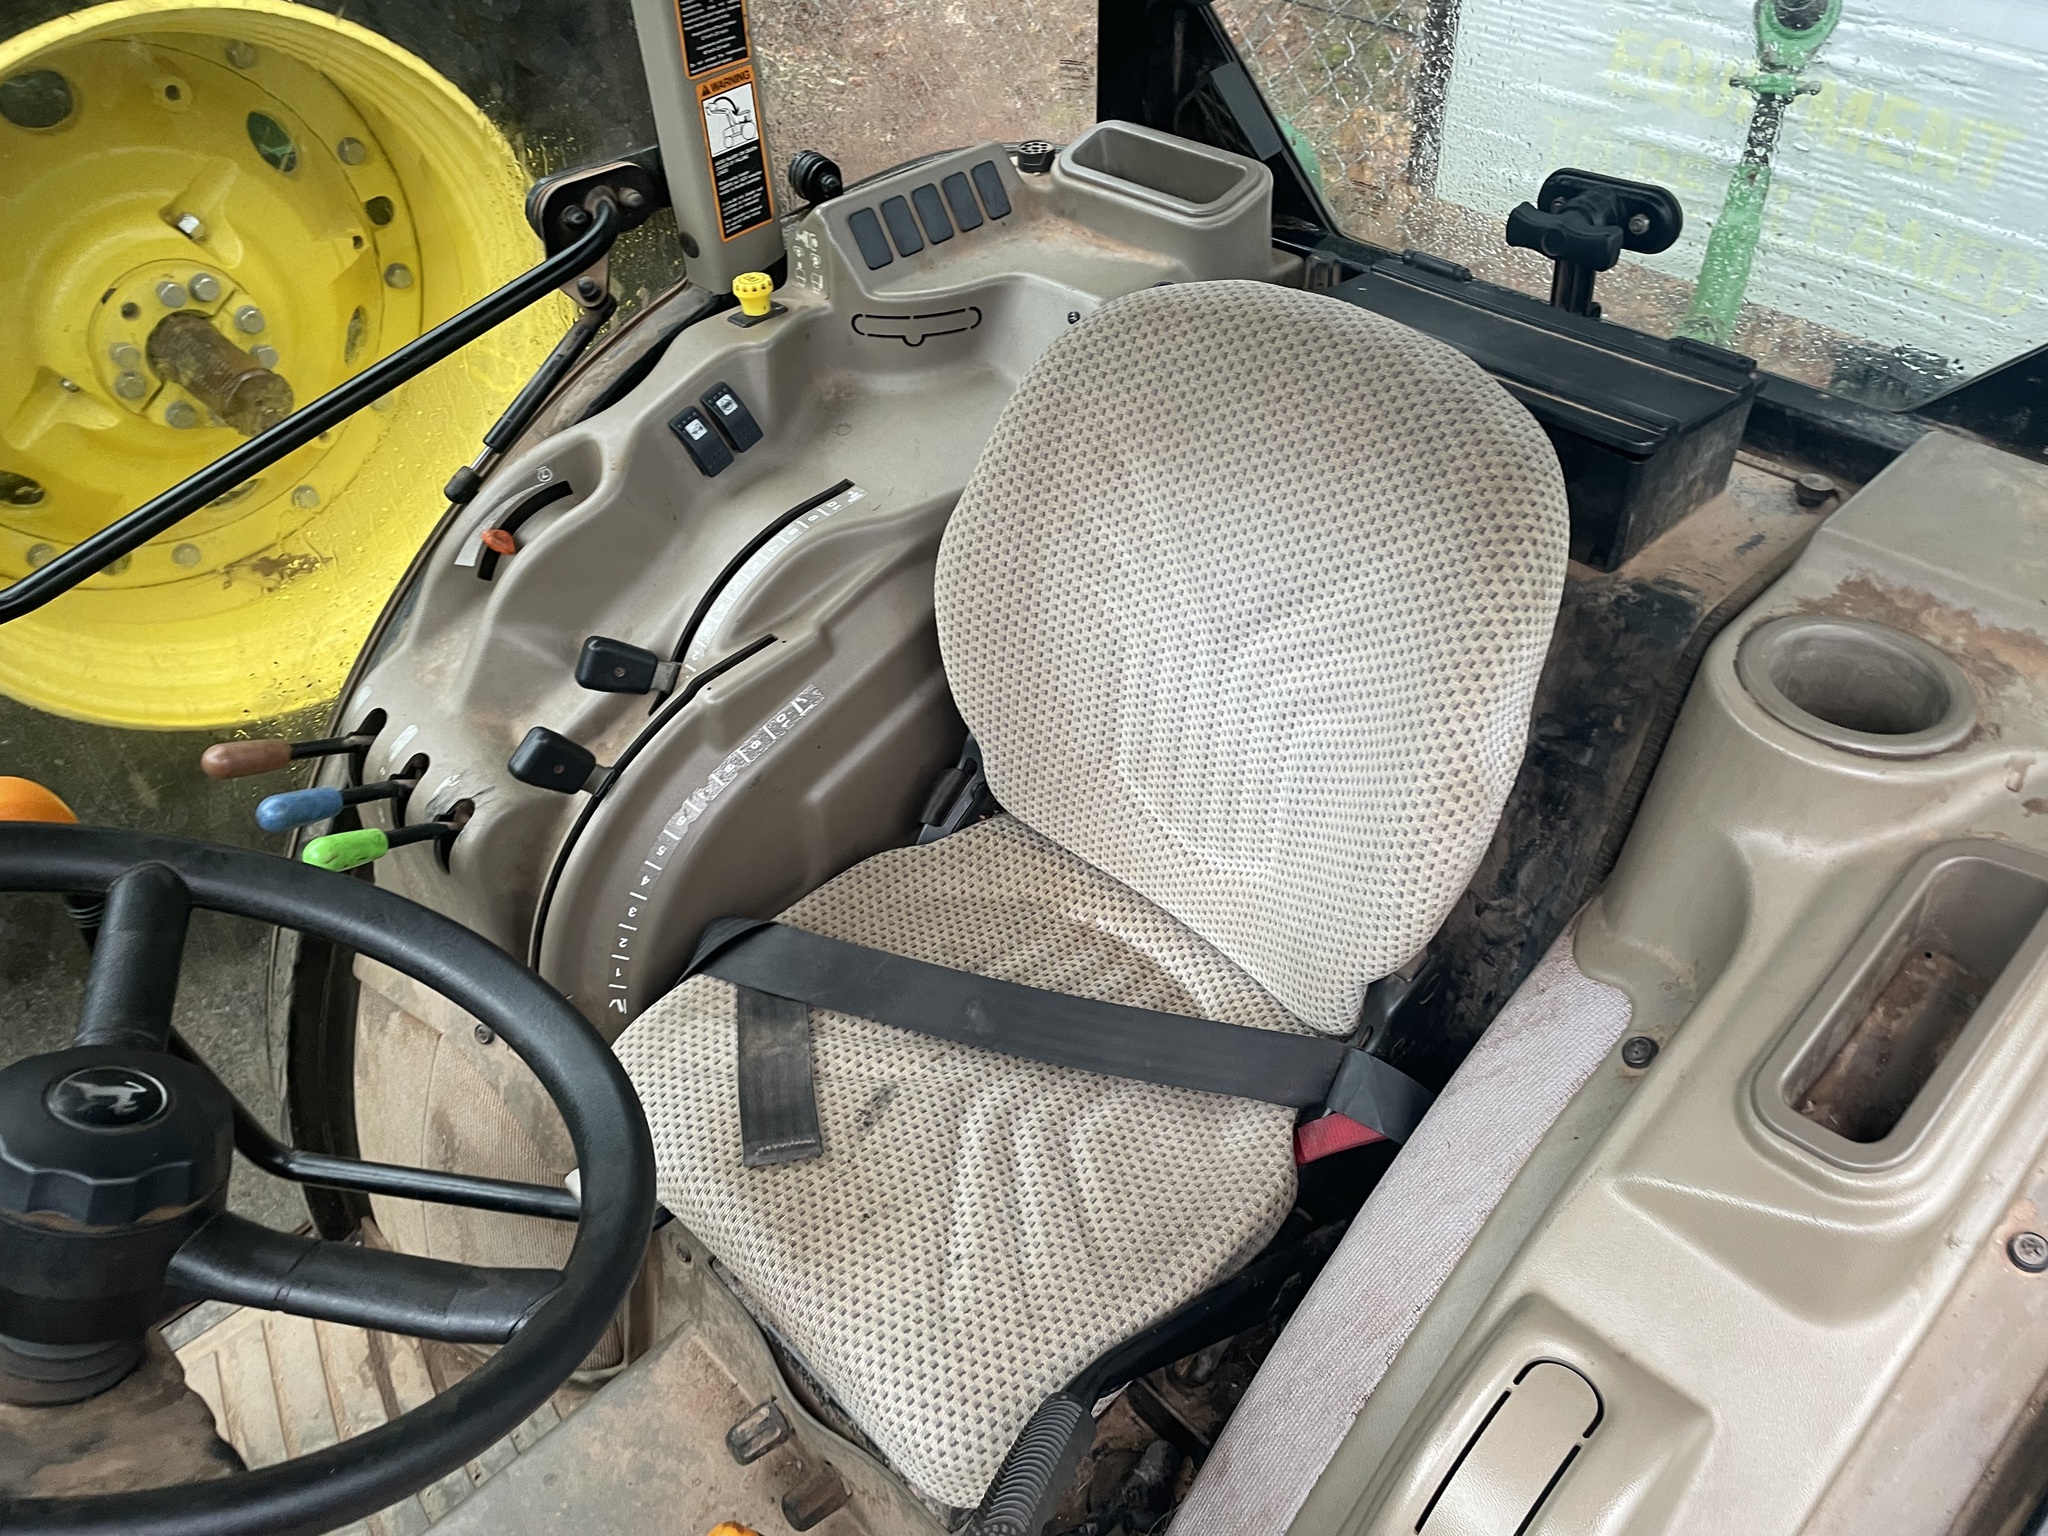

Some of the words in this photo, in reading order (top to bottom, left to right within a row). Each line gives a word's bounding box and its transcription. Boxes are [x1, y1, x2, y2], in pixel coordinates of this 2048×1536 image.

[710, 70, 751, 93] WARNING
[1604, 25, 2028, 192] EQUIMENT
[1541, 113, 1615, 177] TO
[1632, 141, 1713, 195] BE
[1756, 180, 2042, 317] LEANED
[826, 500, 842, 512] 10
[776, 713, 790, 728] 10
[676, 815, 686, 826] 6
[655, 845, 668, 857] 5
[641, 875, 651, 886] 4
[627, 906, 637, 918] 3
[618, 937, 628, 948] 2
[615, 967, 622, 978] 1
